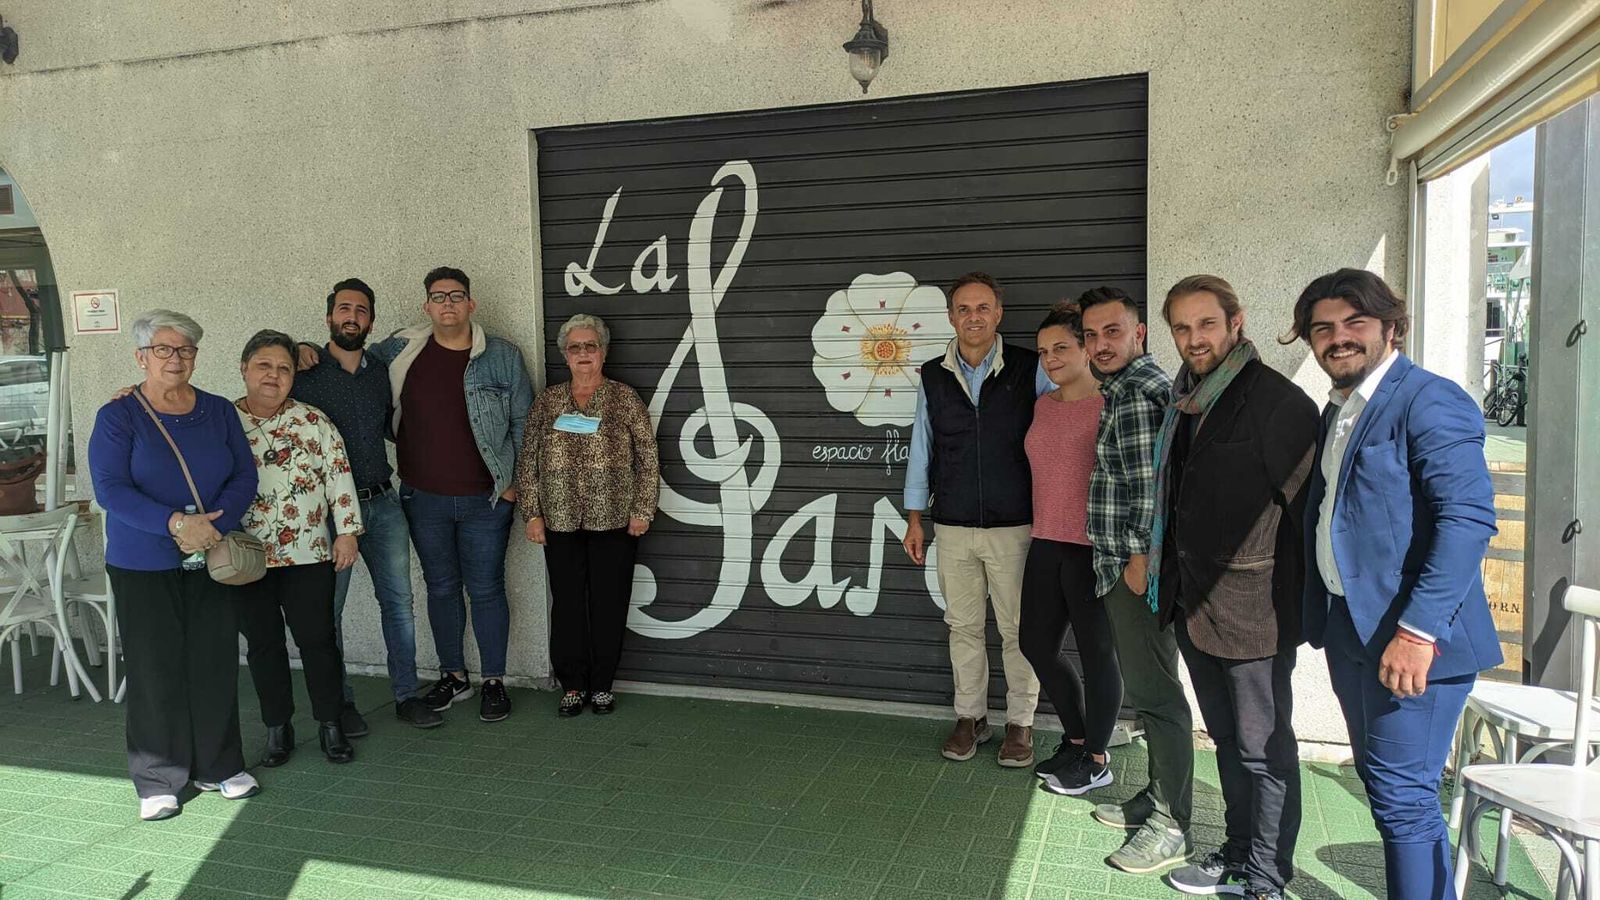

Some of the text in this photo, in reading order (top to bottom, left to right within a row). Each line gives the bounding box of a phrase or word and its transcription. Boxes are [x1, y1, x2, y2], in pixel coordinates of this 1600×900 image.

[564, 186, 678, 297] La
[812, 429, 911, 476] espacio fla
